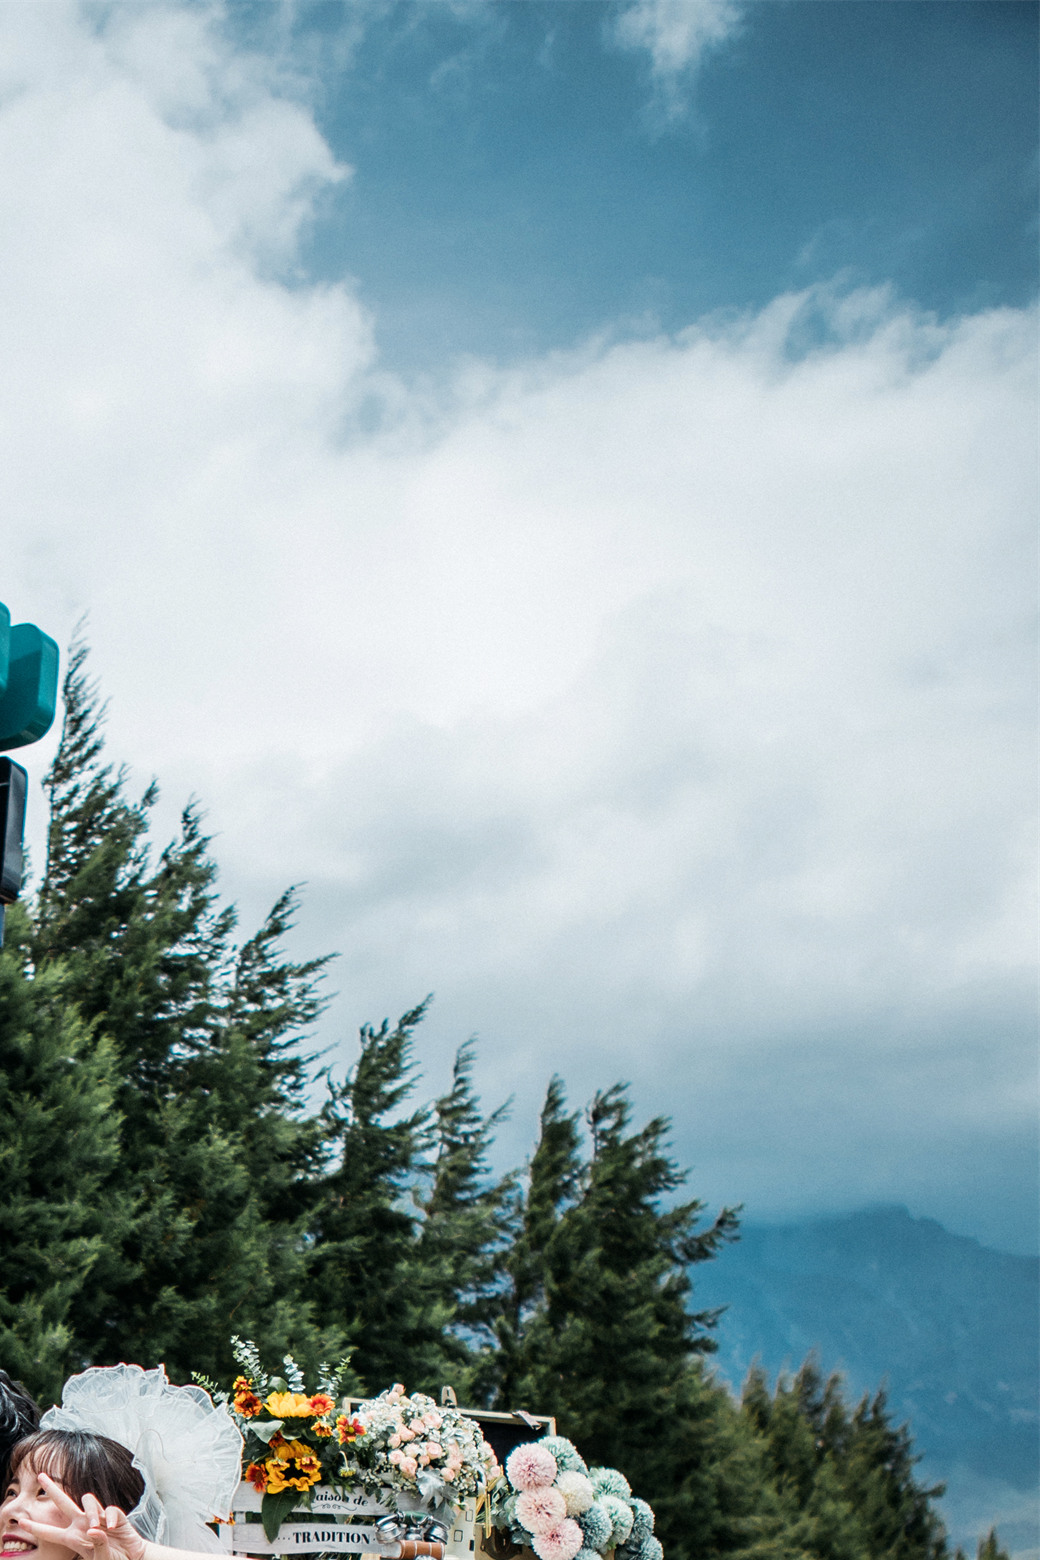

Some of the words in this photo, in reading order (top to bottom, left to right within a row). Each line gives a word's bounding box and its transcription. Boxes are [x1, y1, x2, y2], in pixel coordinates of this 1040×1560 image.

[313, 1491, 349, 1503] aison
[353, 1495, 368, 1506] de
[293, 1531, 370, 1544] TRADITION
